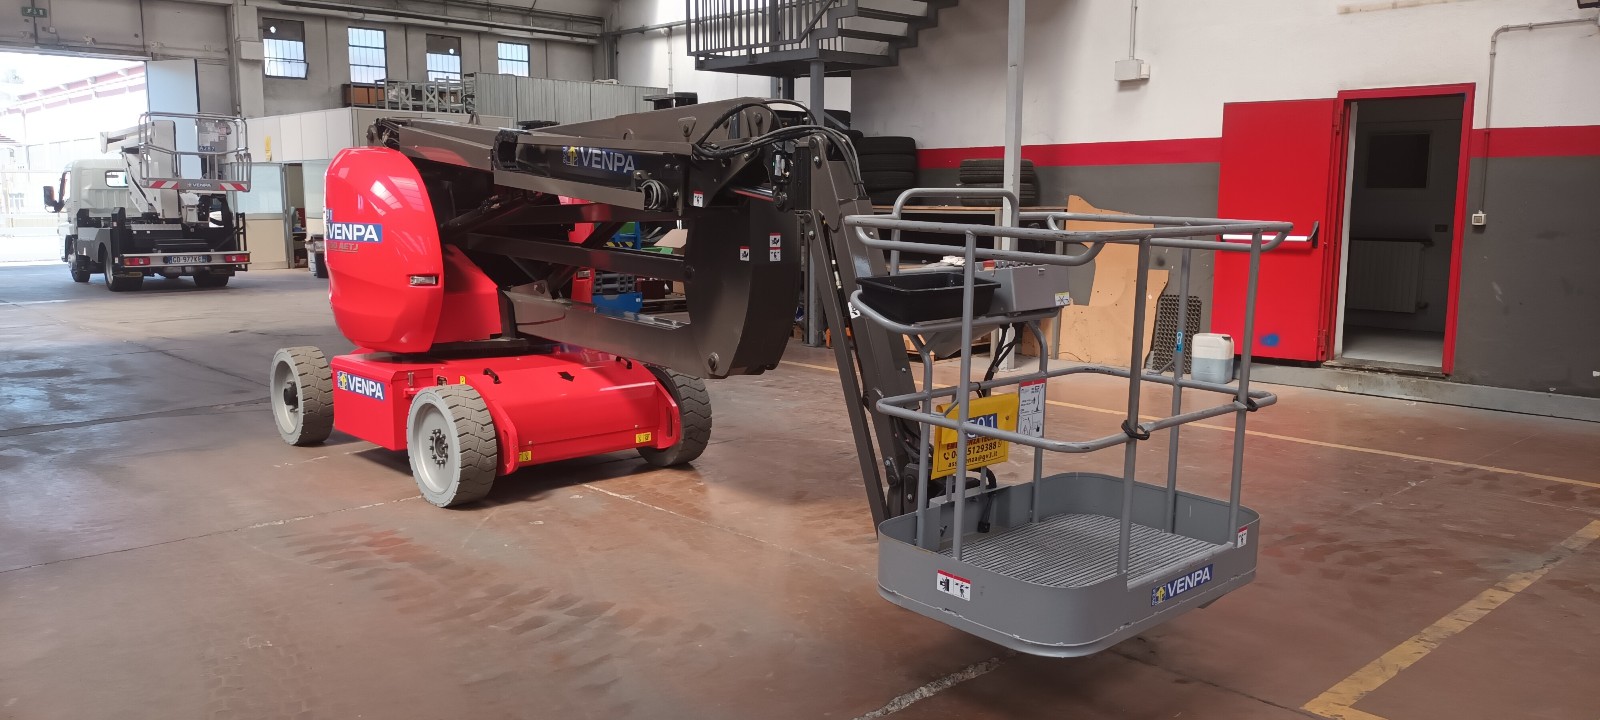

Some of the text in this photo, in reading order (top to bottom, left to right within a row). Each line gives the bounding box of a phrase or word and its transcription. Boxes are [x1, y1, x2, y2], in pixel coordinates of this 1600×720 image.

[580, 146, 635, 173] VENPA
[328, 223, 379, 242] VENPA
[347, 374, 384, 400] VENPA
[1167, 566, 1211, 597] VENPA
